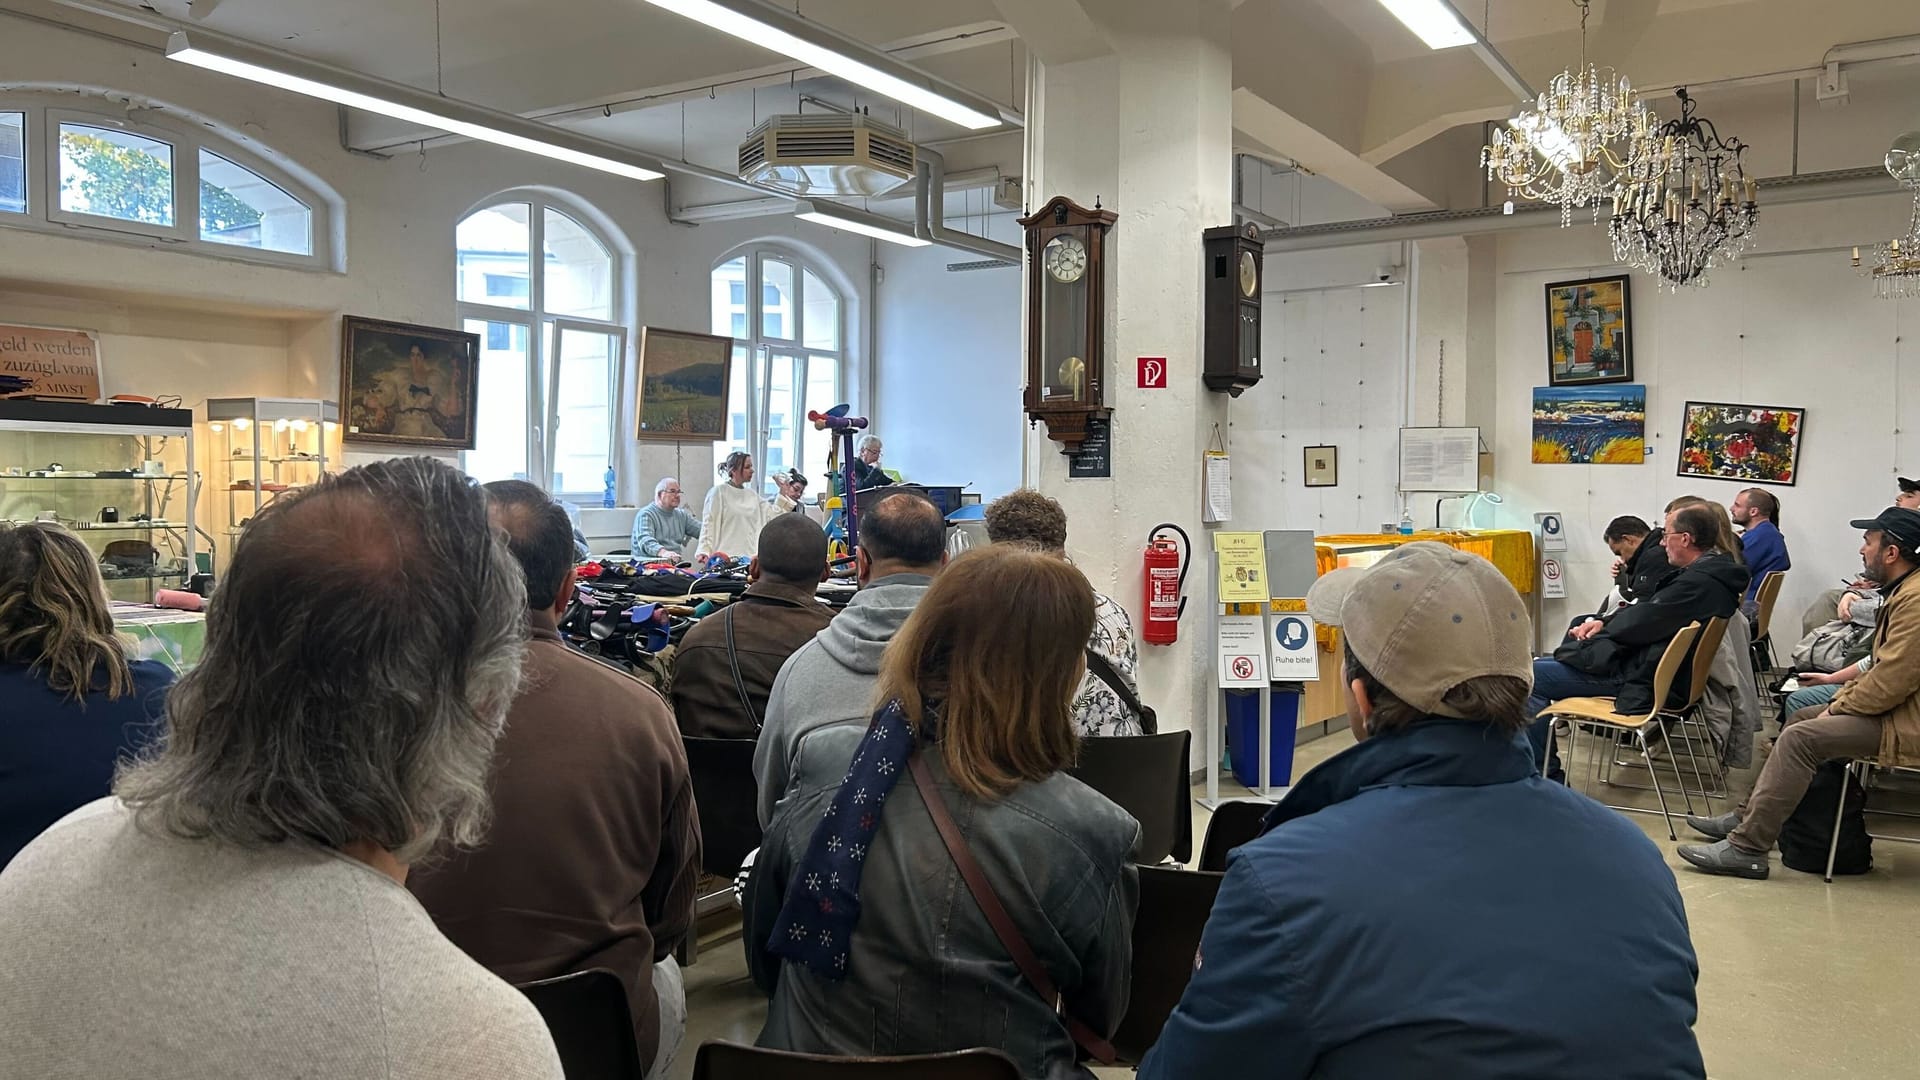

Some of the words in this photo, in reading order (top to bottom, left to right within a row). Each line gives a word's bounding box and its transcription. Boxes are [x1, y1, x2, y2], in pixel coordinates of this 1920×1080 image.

[0, 336, 27, 353] eld
[33, 340, 92, 356] werden
[4, 359, 61, 377] zuzügl.
[62, 364, 94, 376] vom
[47, 383, 87, 395] MWST
[1275, 656, 1295, 664] Ruhe
[1295, 656, 1313, 664] bitte!
